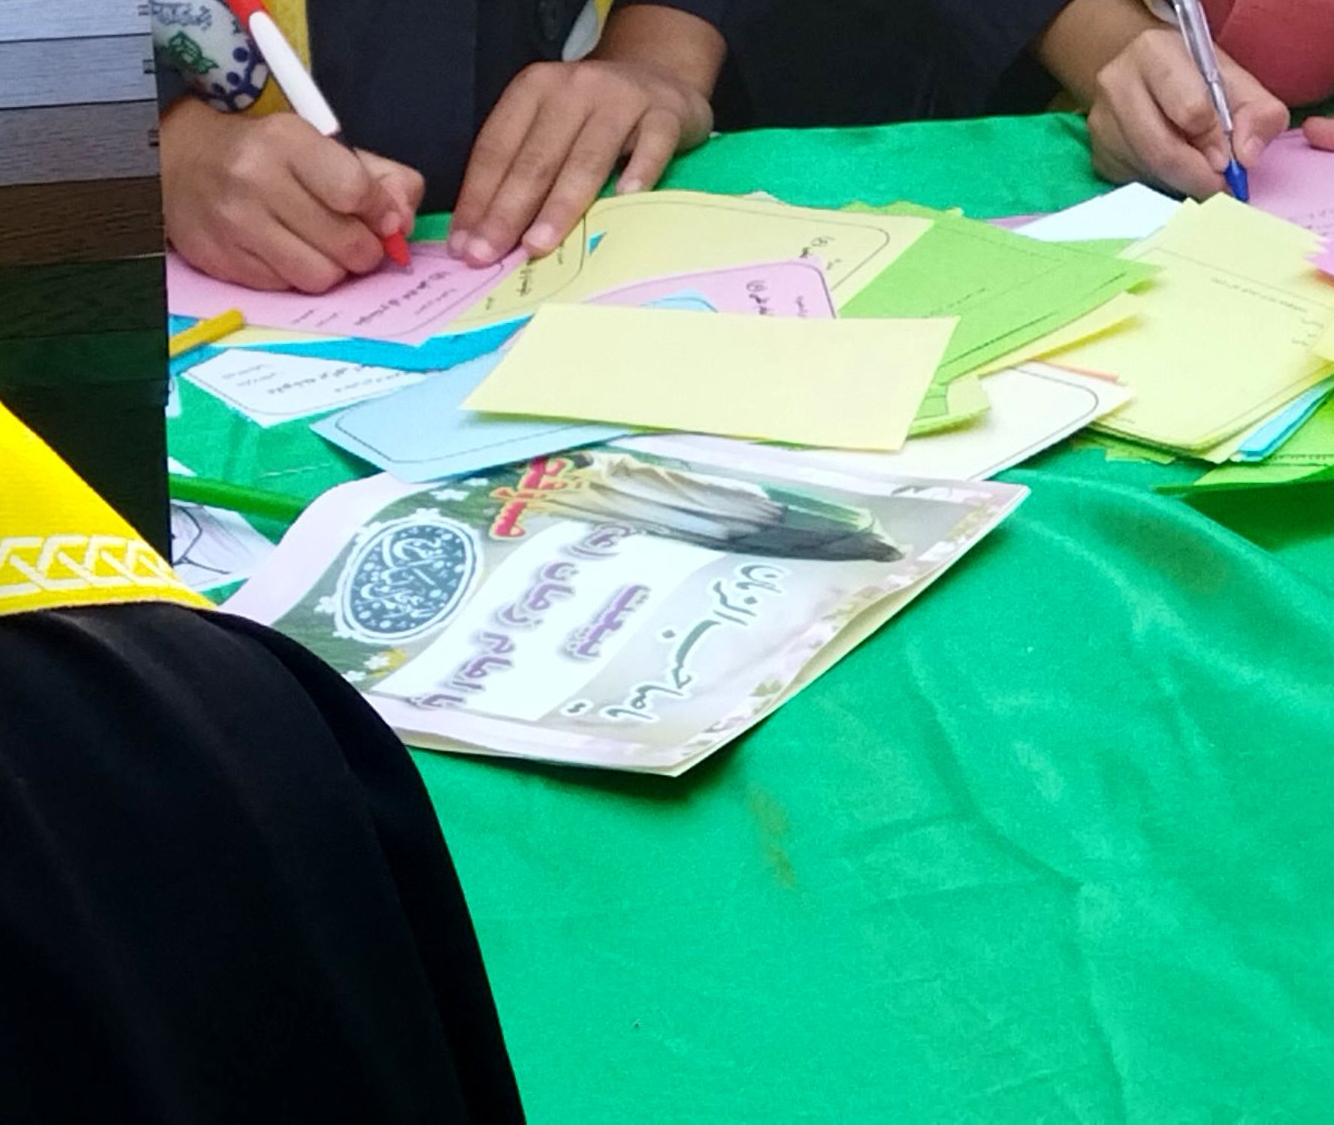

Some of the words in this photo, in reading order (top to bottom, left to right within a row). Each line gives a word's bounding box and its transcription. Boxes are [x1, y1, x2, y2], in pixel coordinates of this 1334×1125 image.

[452, 631, 515, 691] امام
[501, 562, 578, 627] زمان
[571, 584, 649, 657] بیعت
